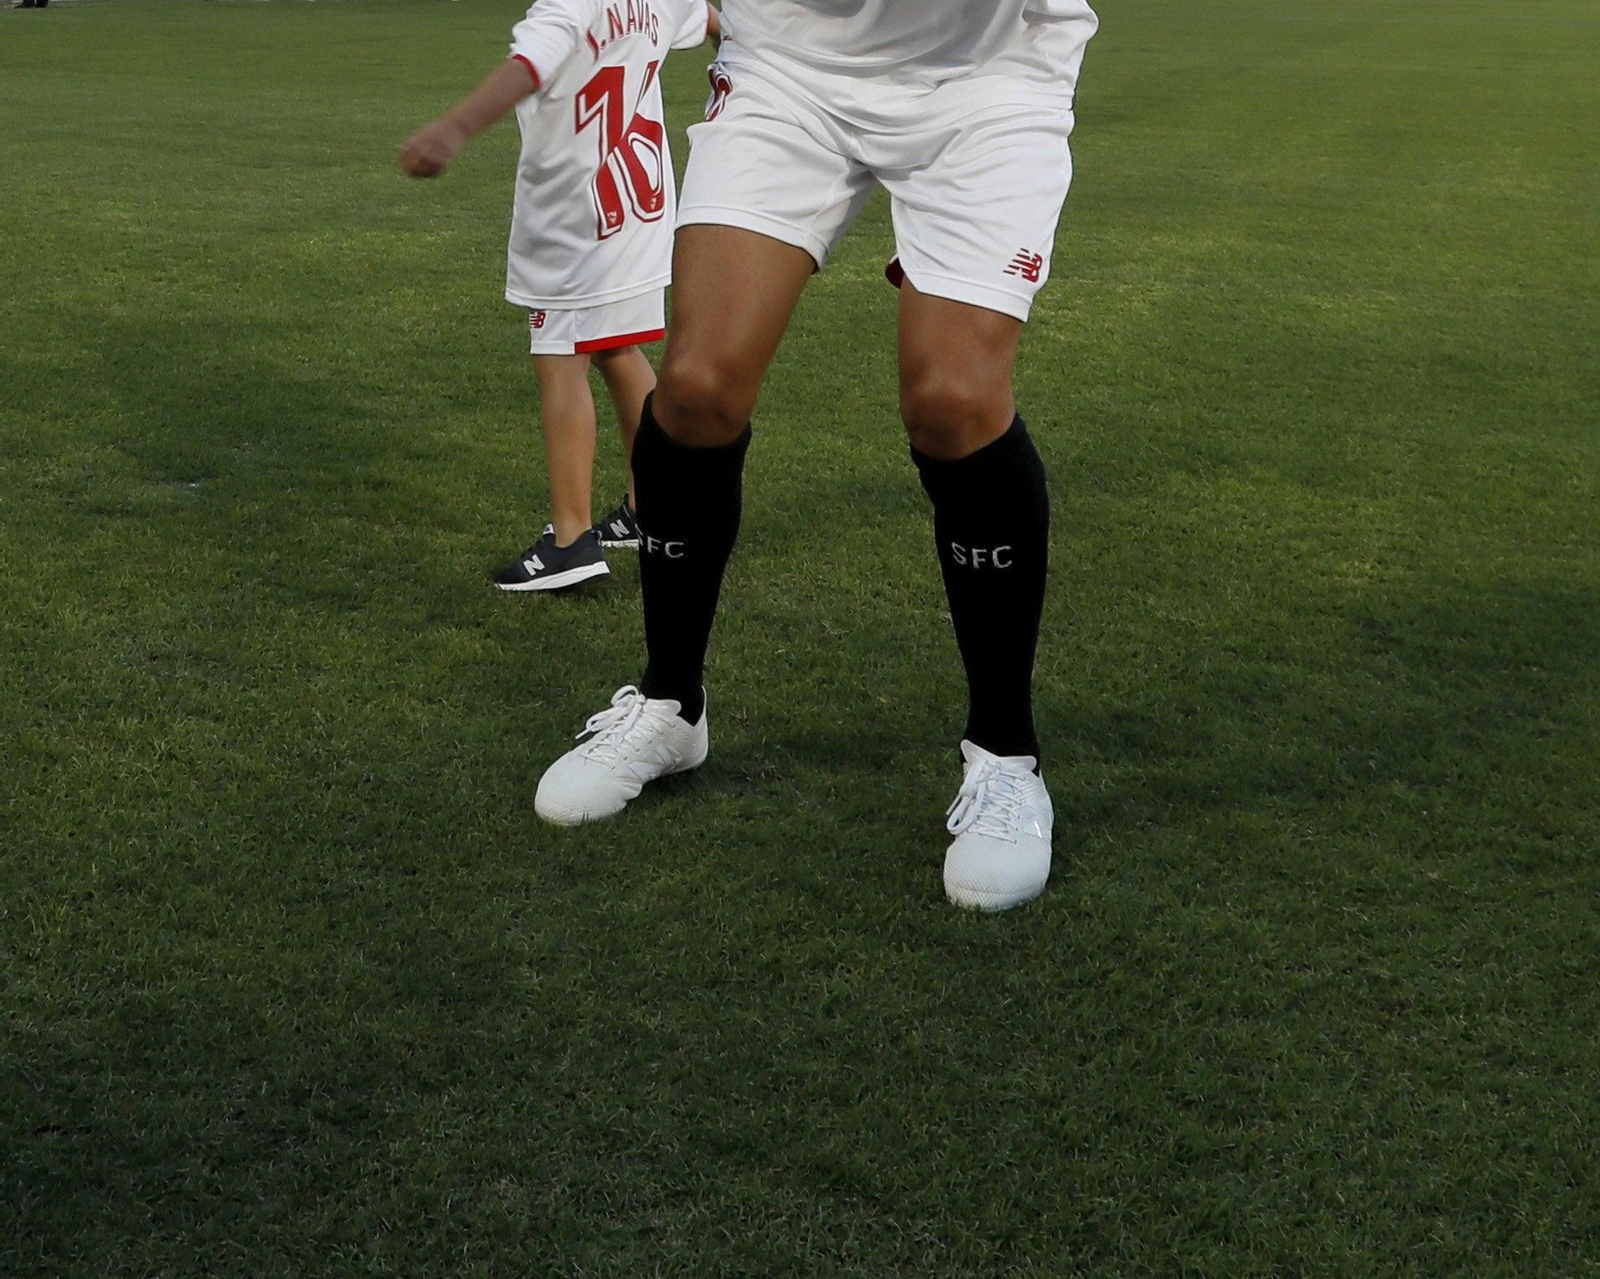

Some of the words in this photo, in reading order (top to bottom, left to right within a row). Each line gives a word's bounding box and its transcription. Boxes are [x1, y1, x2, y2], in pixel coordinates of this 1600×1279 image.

[574, 59, 665, 241] 16
[522, 553, 546, 576] N
[951, 542, 1013, 570] SFC
